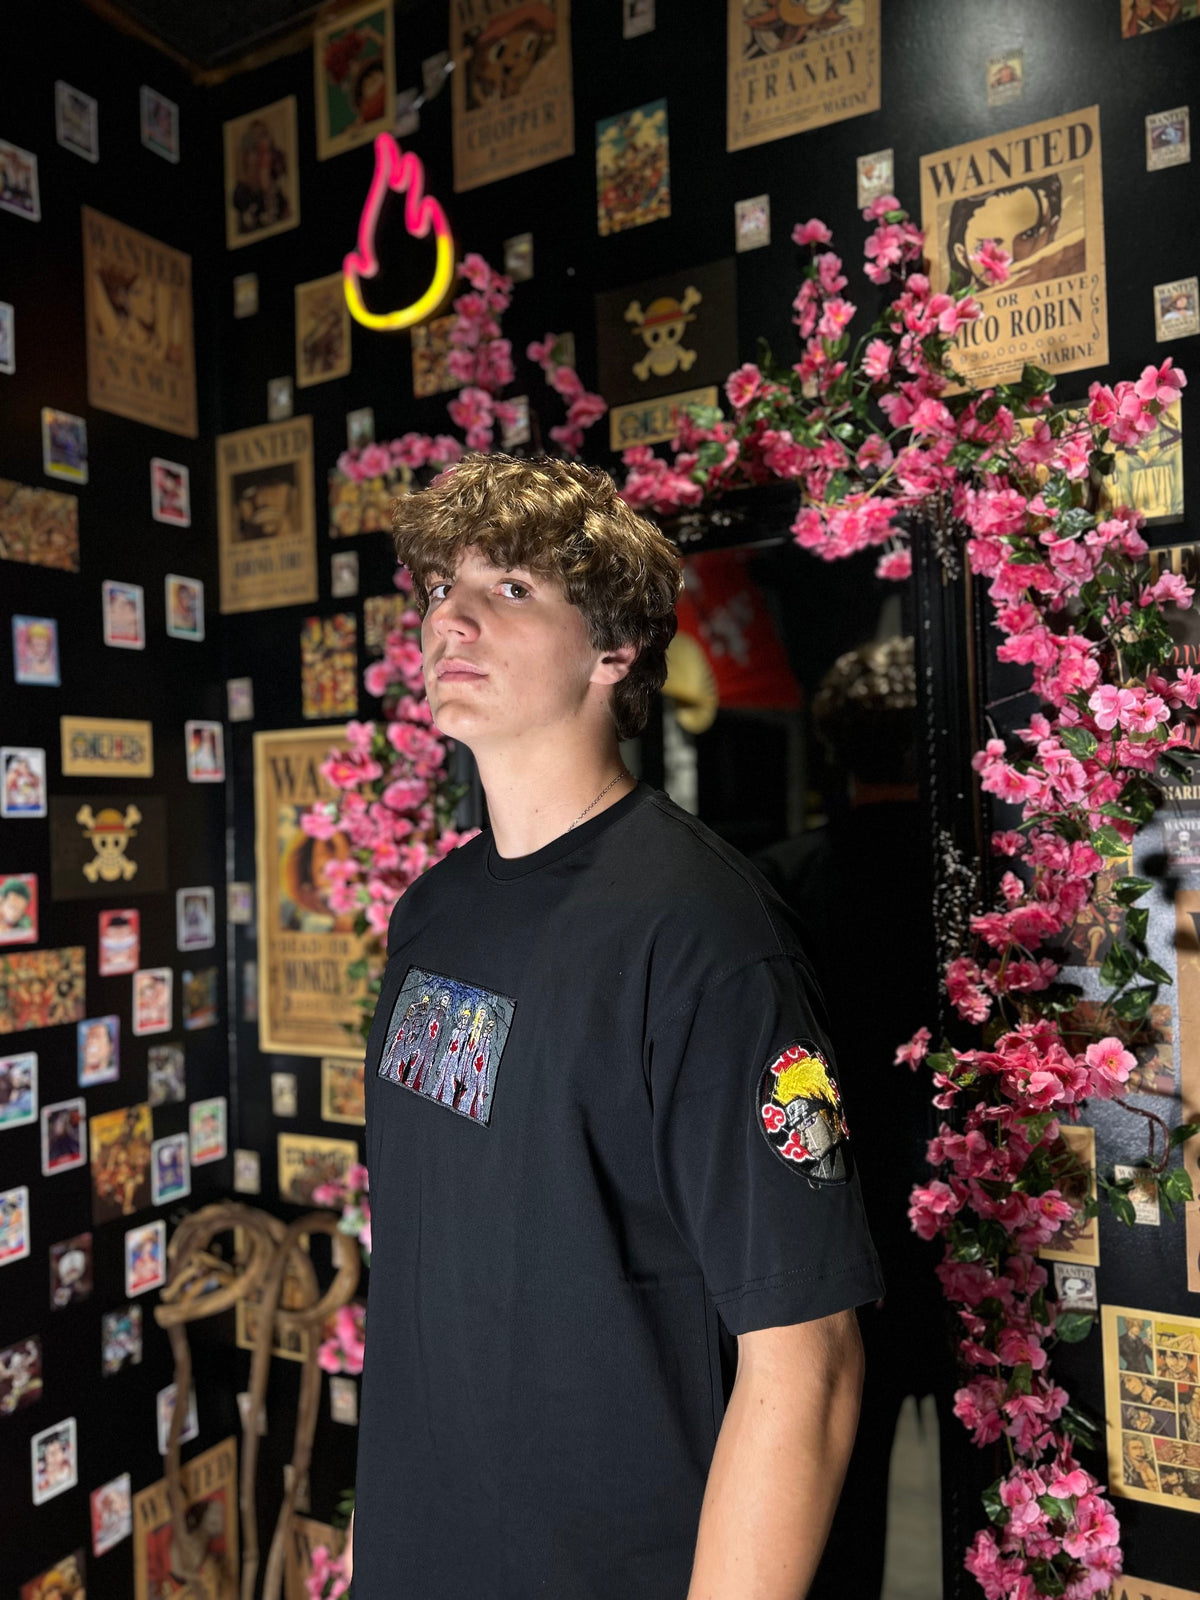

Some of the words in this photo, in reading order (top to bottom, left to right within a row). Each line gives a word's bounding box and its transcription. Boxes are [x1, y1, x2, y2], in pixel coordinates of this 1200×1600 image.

[747, 46, 860, 106] FRANKY
[927, 121, 1094, 199] WANTED
[996, 293, 1018, 309] OR
[1032, 277, 1089, 301] ALIVE
[1011, 296, 1084, 339] ROBIN
[1039, 341, 1096, 366] MARINE
